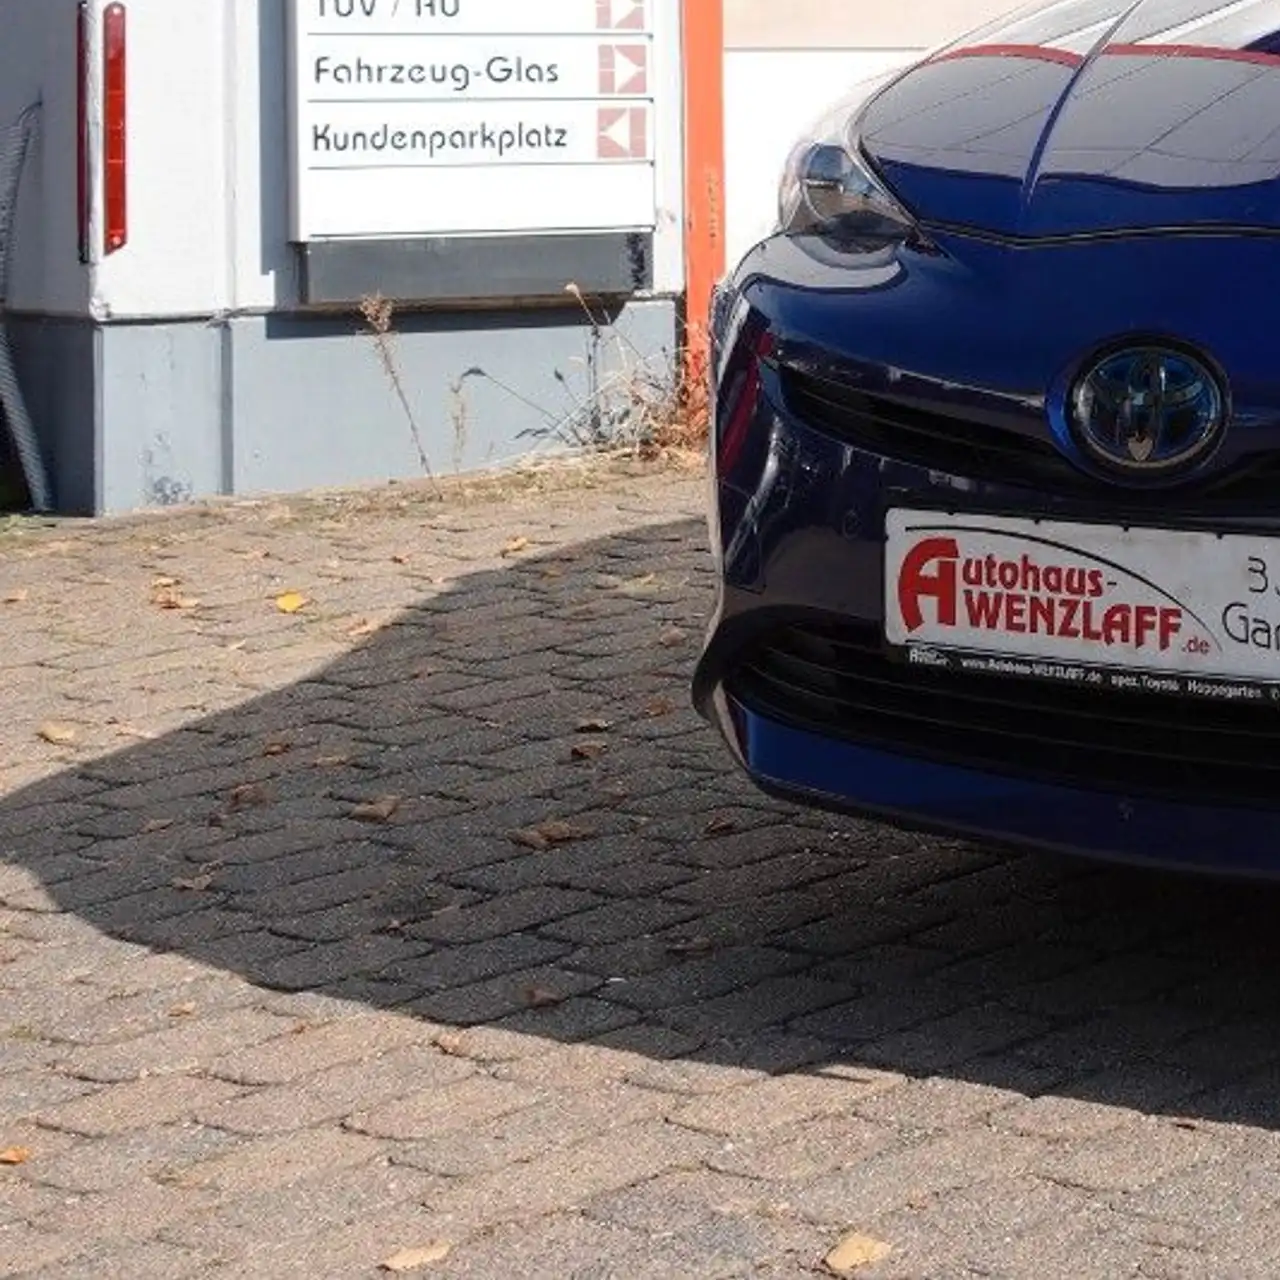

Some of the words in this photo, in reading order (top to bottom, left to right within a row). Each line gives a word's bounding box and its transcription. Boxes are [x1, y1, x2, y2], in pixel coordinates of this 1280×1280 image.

[313, 56, 560, 91] Fahrzeug-Glas
[311, 122, 569, 158] Kundenparkplatz
[1247, 555, 1269, 594] 3
